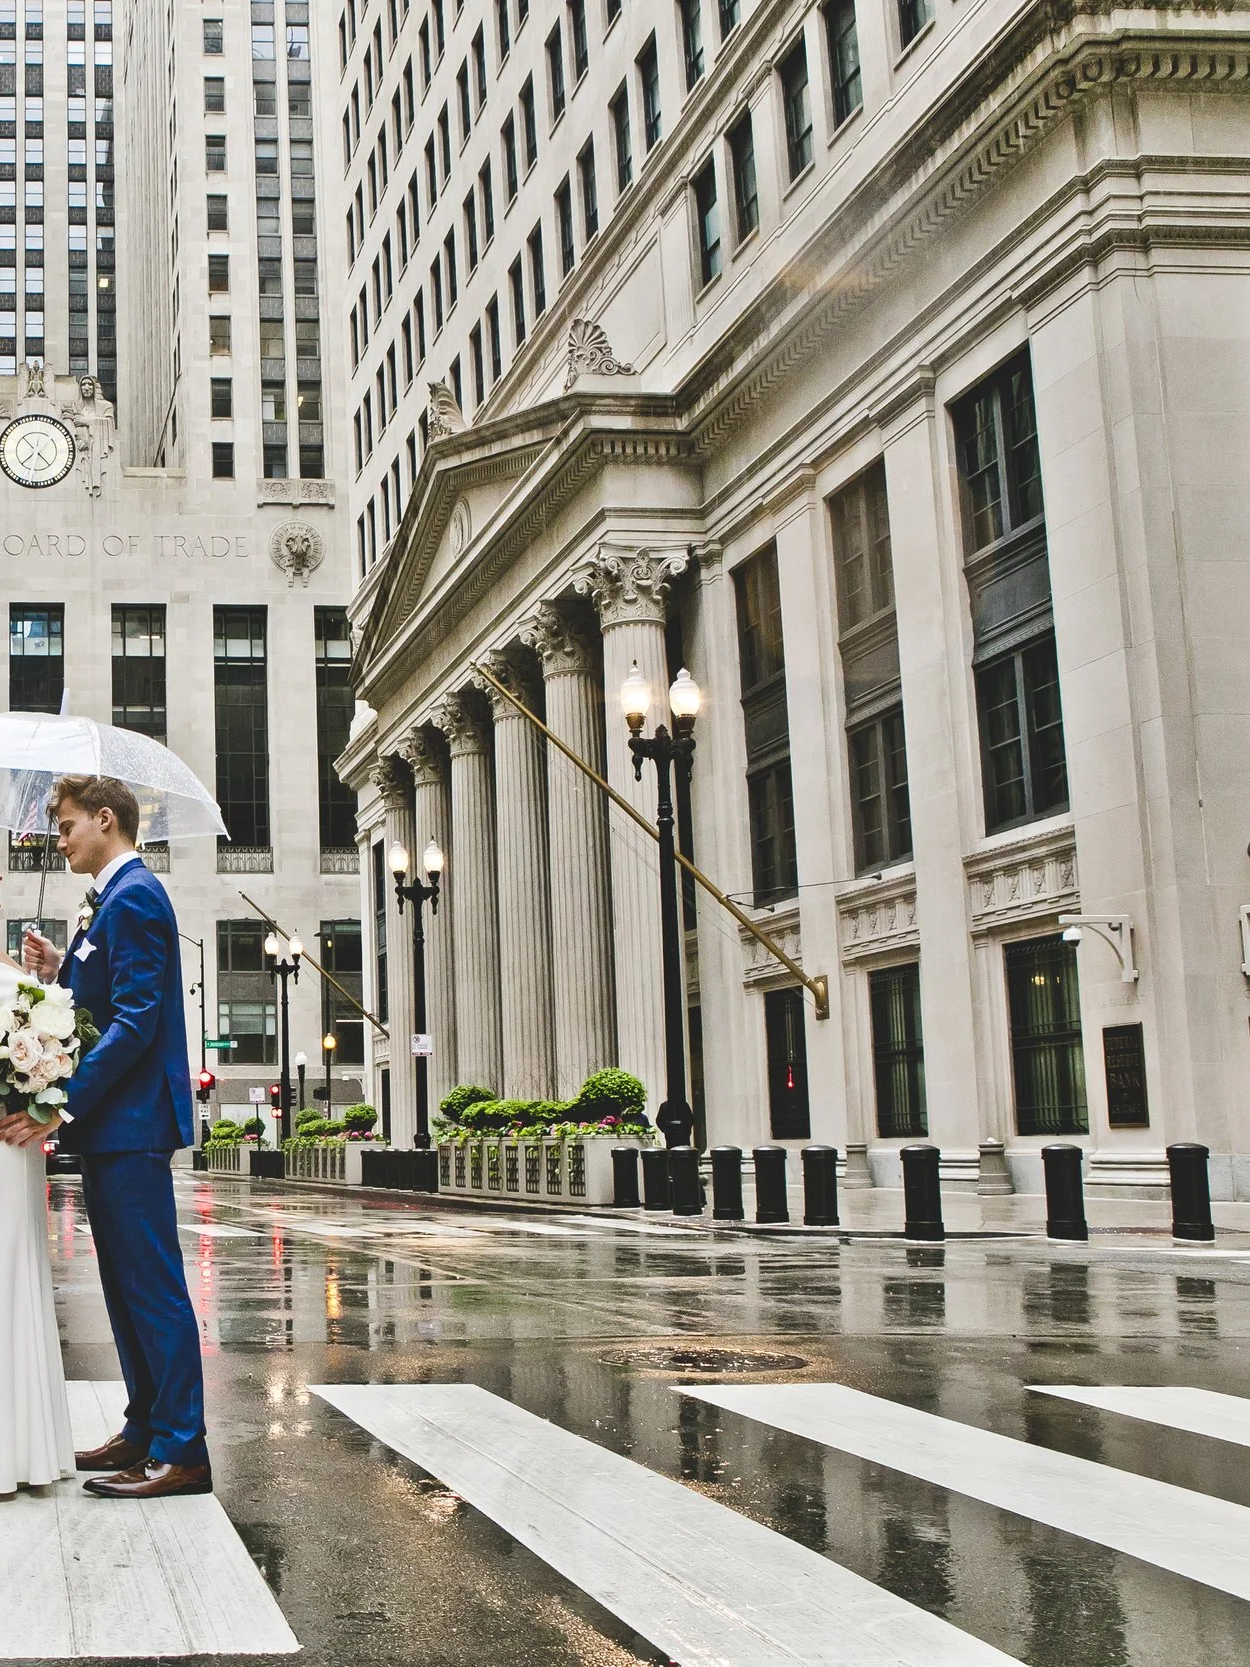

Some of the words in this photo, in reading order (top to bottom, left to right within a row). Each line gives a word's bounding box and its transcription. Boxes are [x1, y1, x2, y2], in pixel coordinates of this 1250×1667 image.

[102, 533, 140, 557] OF
[154, 534, 249, 557] TRADE
[1109, 1072, 1141, 1089] BANK
